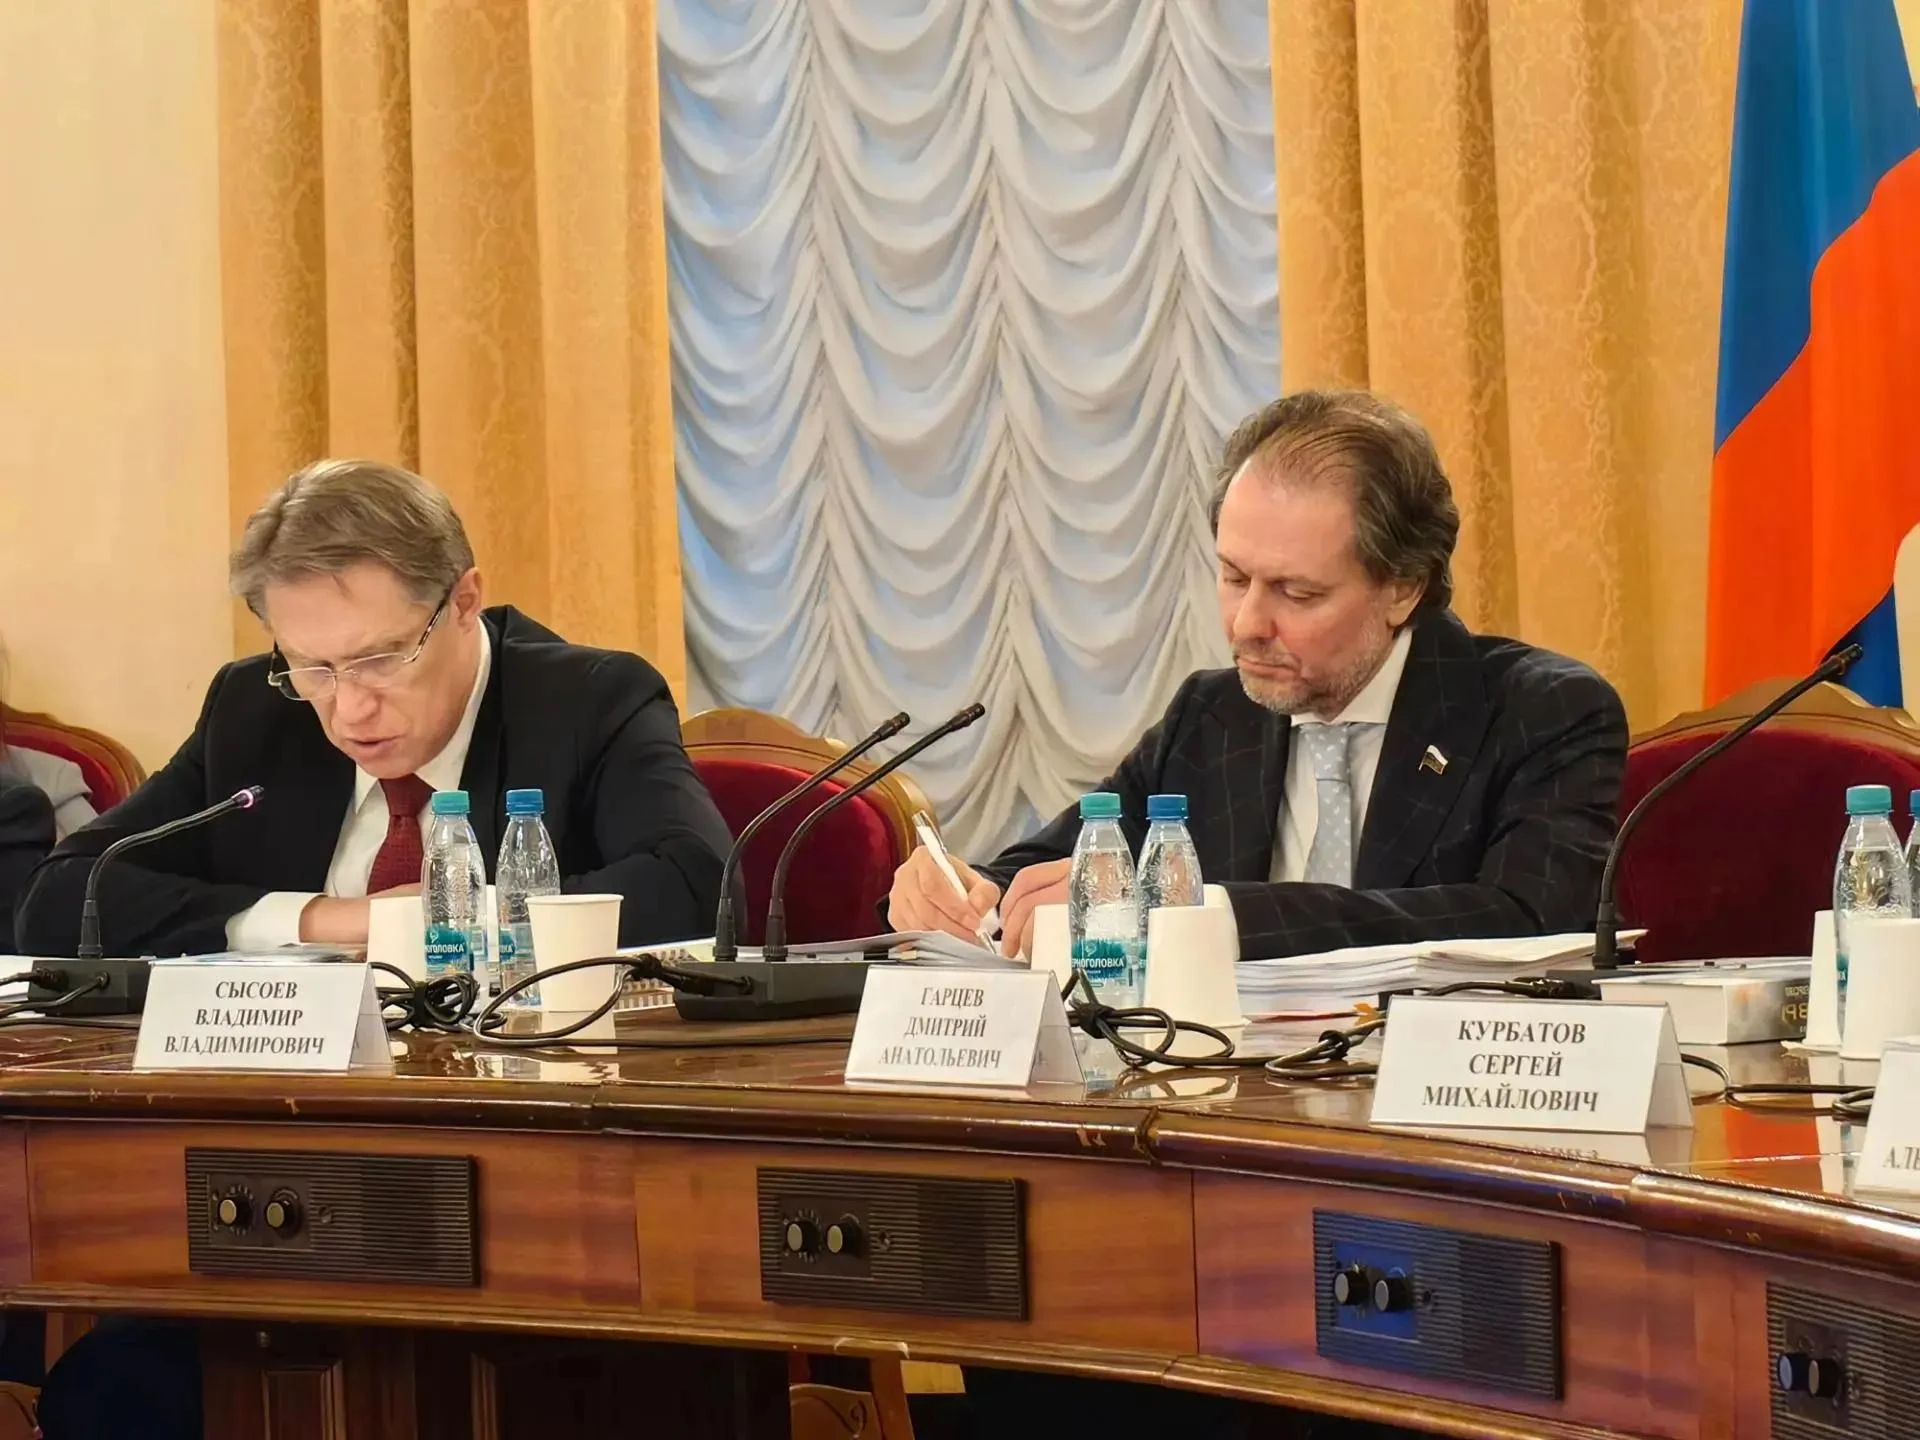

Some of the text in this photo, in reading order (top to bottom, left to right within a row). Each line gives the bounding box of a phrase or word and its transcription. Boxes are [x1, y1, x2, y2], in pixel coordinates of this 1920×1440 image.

[215, 981, 298, 999] СЫСОЕВ
[920, 987, 984, 1008] ГАРЦЕВ
[195, 1008, 303, 1027] ВЛАДИМИР
[904, 1015, 987, 1038] ДМИТРИЙ
[1457, 1020, 1586, 1044] КУРБАТОВ
[164, 1035, 324, 1056] ВЛАДИМИРОВИЧ
[878, 1046, 1002, 1069] АНАТОЛЬЕВИЧ
[1468, 1051, 1563, 1077] СЕРГЕЙ
[1422, 1083, 1599, 1112] МИХАЙЛОВИЧ
